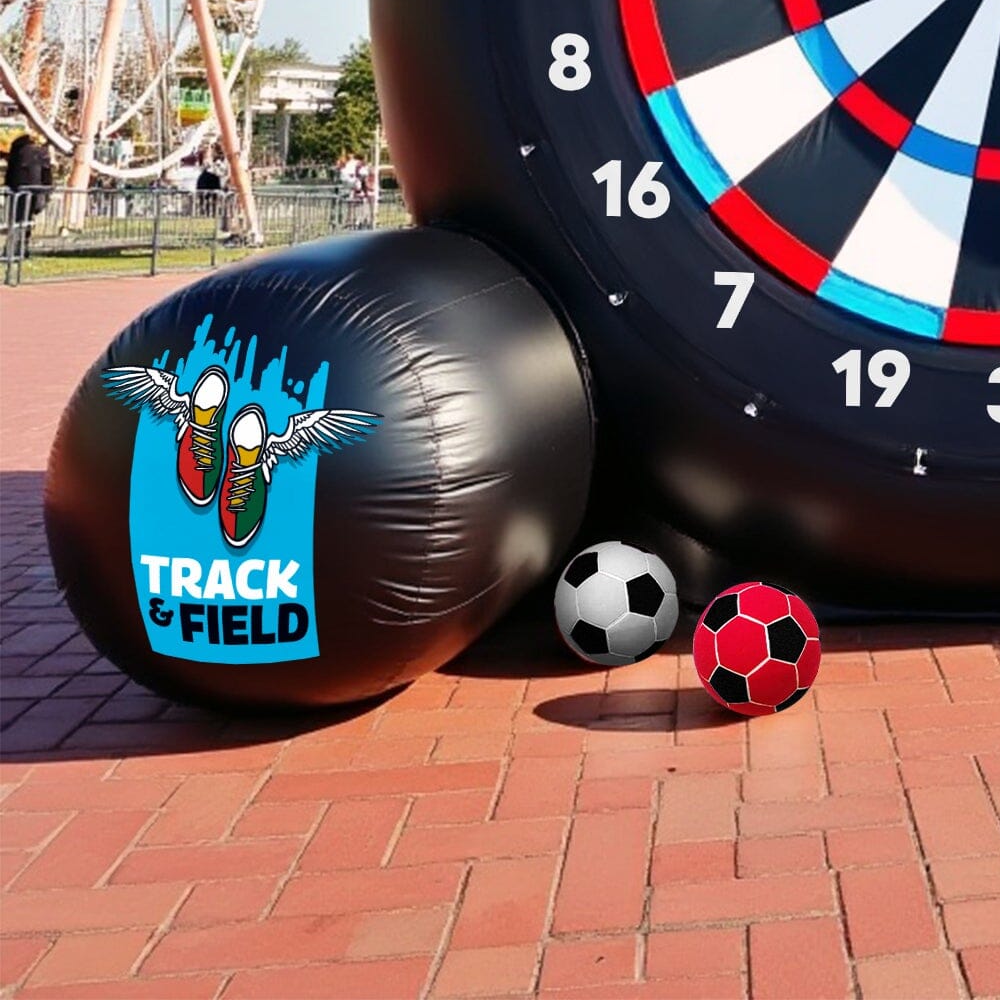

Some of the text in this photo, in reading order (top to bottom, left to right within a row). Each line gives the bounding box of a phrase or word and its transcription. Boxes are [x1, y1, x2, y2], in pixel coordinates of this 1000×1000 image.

[549, 33, 591, 91] 8
[592, 160, 670, 218] 16
[715, 272, 754, 328] 7
[832, 350, 910, 407] 19
[140, 554, 300, 600] TRACK
[180, 603, 309, 645] FIELD
